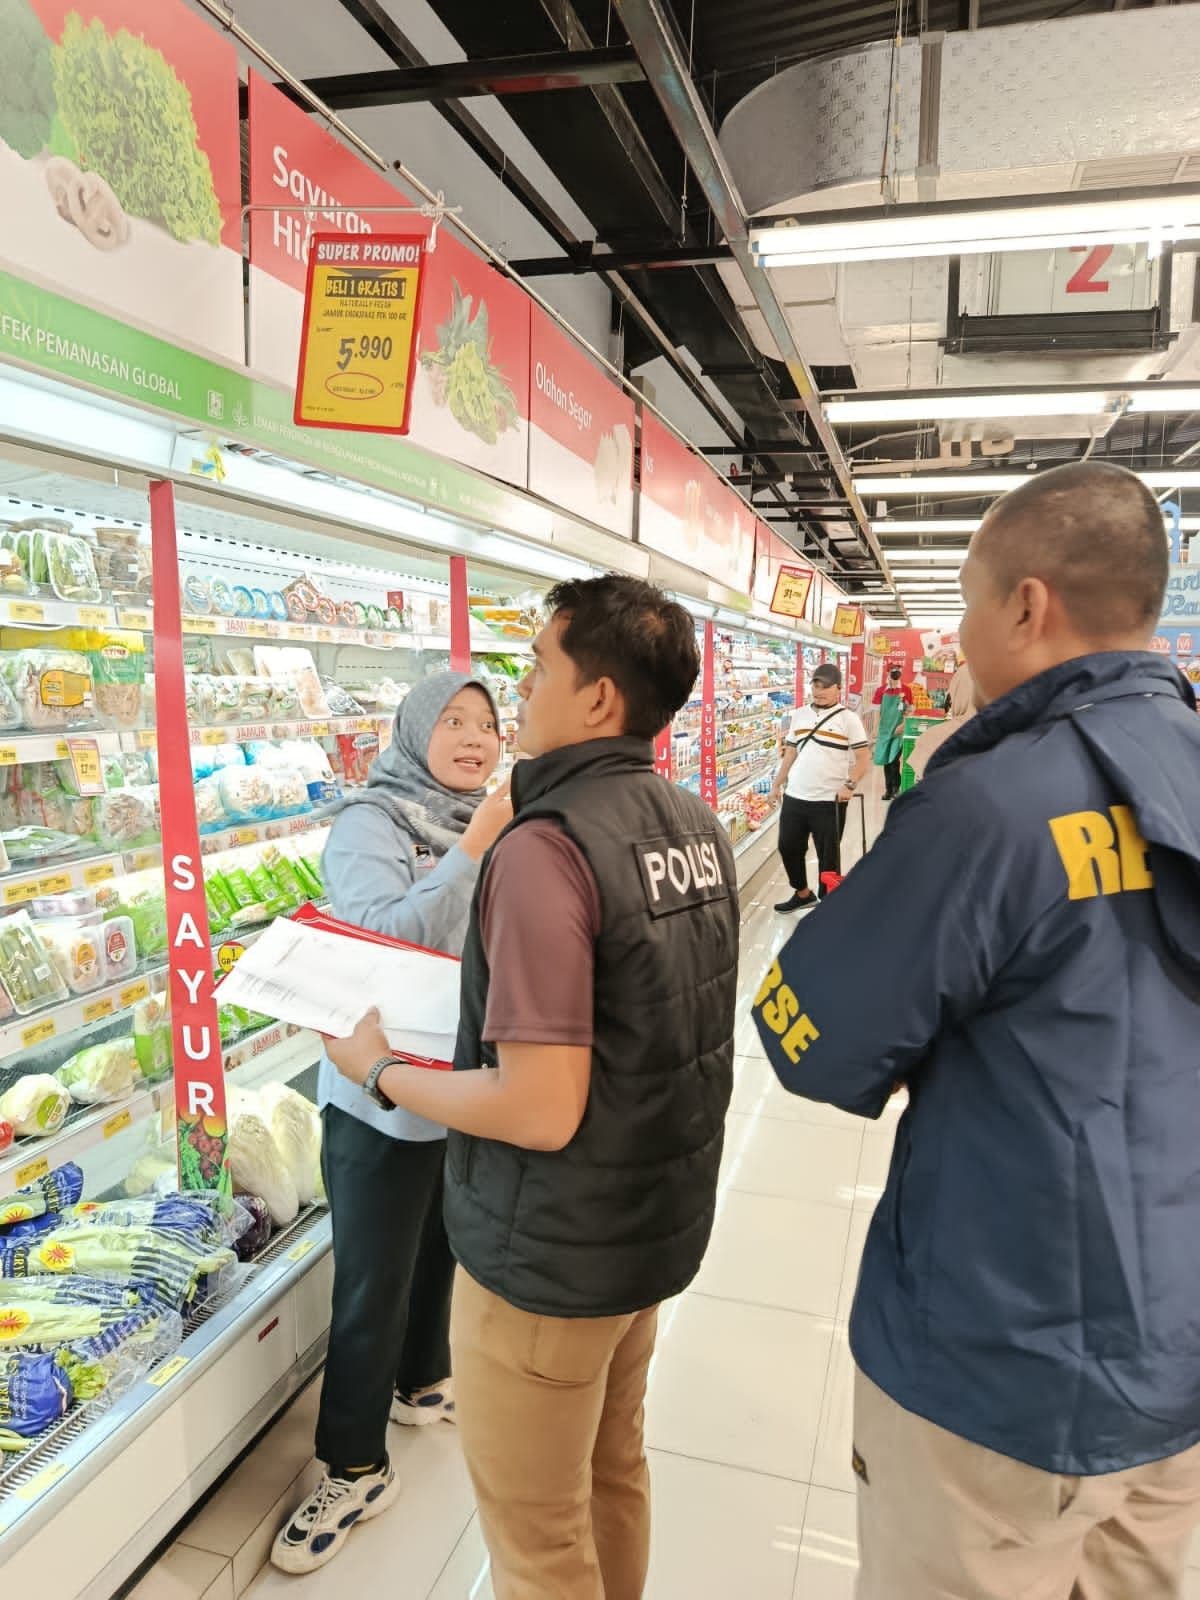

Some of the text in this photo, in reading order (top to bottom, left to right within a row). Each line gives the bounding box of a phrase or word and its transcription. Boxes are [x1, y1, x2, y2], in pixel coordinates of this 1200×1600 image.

[317, 243, 420, 263] SUPER PROMO!
[325, 279, 348, 296] BELI
[350, 279, 356, 295] 1
[357, 279, 399, 297] GRATIS
[1, 314, 182, 399] FEK PEMANASAN GLOBAL
[336, 335, 393, 372] 5.990
[536, 362, 593, 430] Olahan Segar
[704, 703, 713, 748] SUSU
[643, 842, 723, 902] POLISI
[171, 854, 216, 1117] SAYUR
